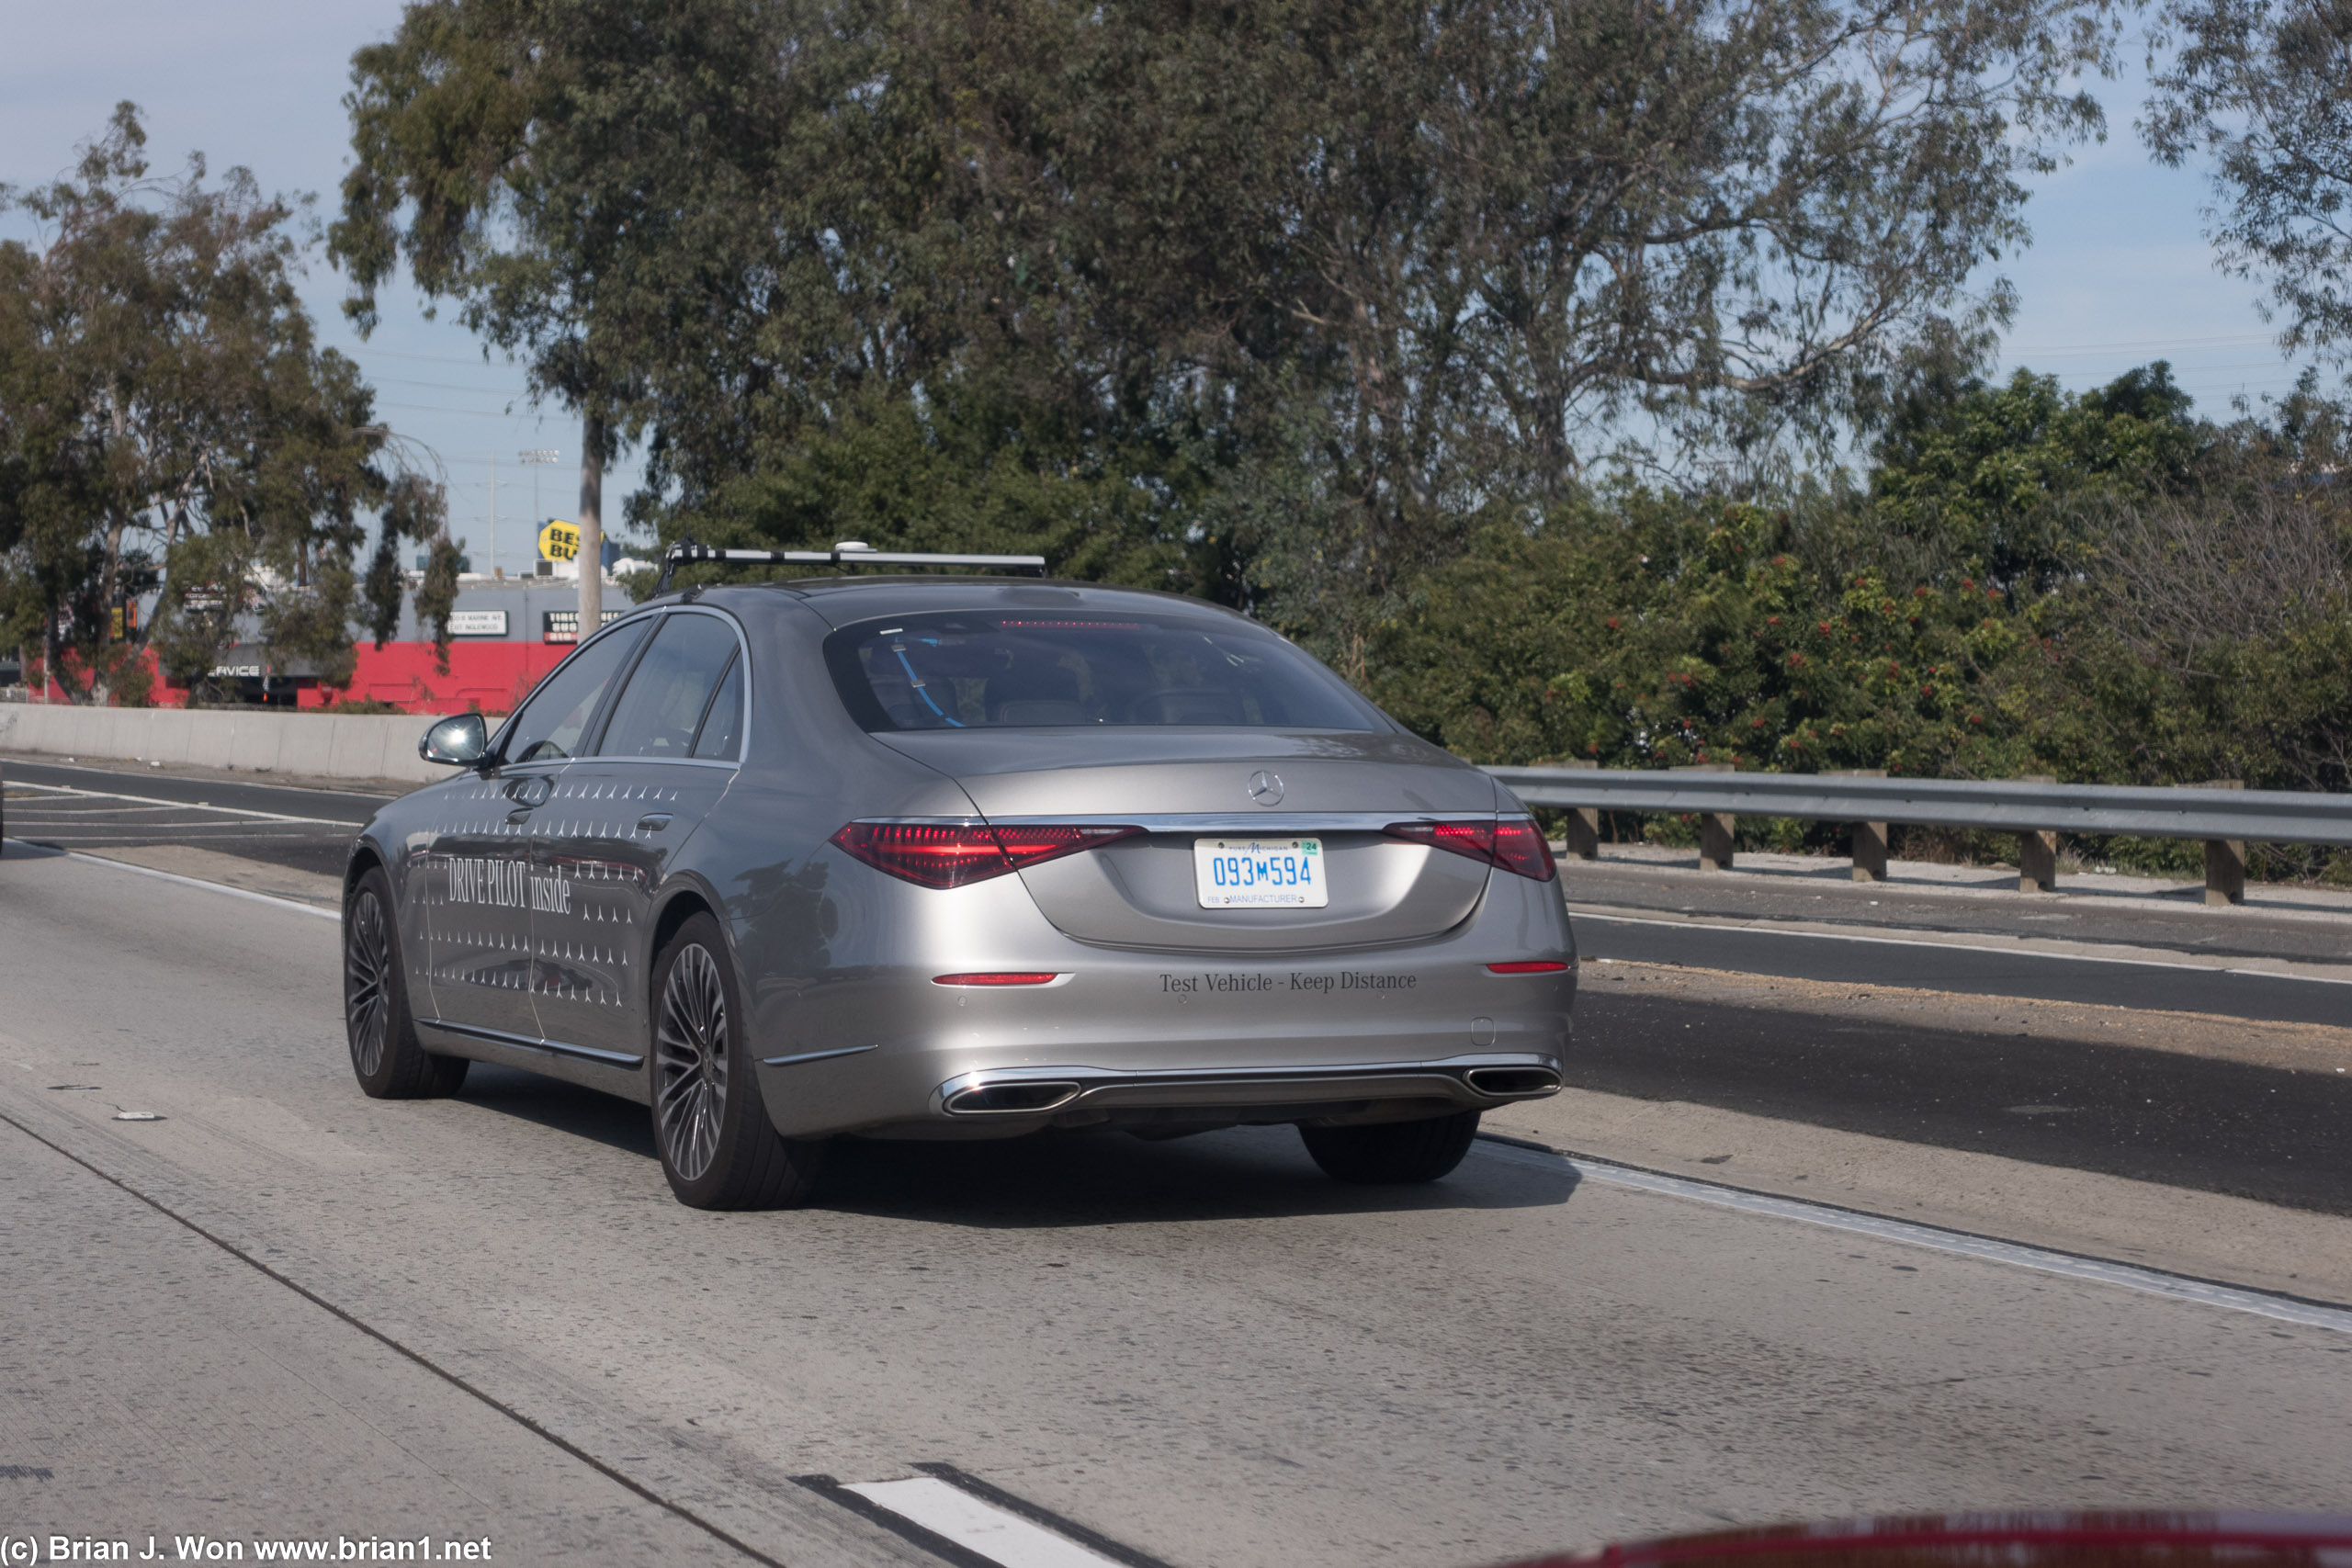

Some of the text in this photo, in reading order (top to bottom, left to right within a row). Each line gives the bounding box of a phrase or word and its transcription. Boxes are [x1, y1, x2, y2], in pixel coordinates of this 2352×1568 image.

[550, 544, 578, 560] BU
[1213, 856, 1311, 886] 093M594
[448, 857, 571, 915] DRIVE PILOT inside
[1229, 895, 1297, 903] MANUFACTURER
[1159, 974, 1199, 992] Test
[1205, 973, 1272, 992] Vehicle
[1290, 972, 1335, 994] Keep
[1340, 971, 1417, 990] Distance
